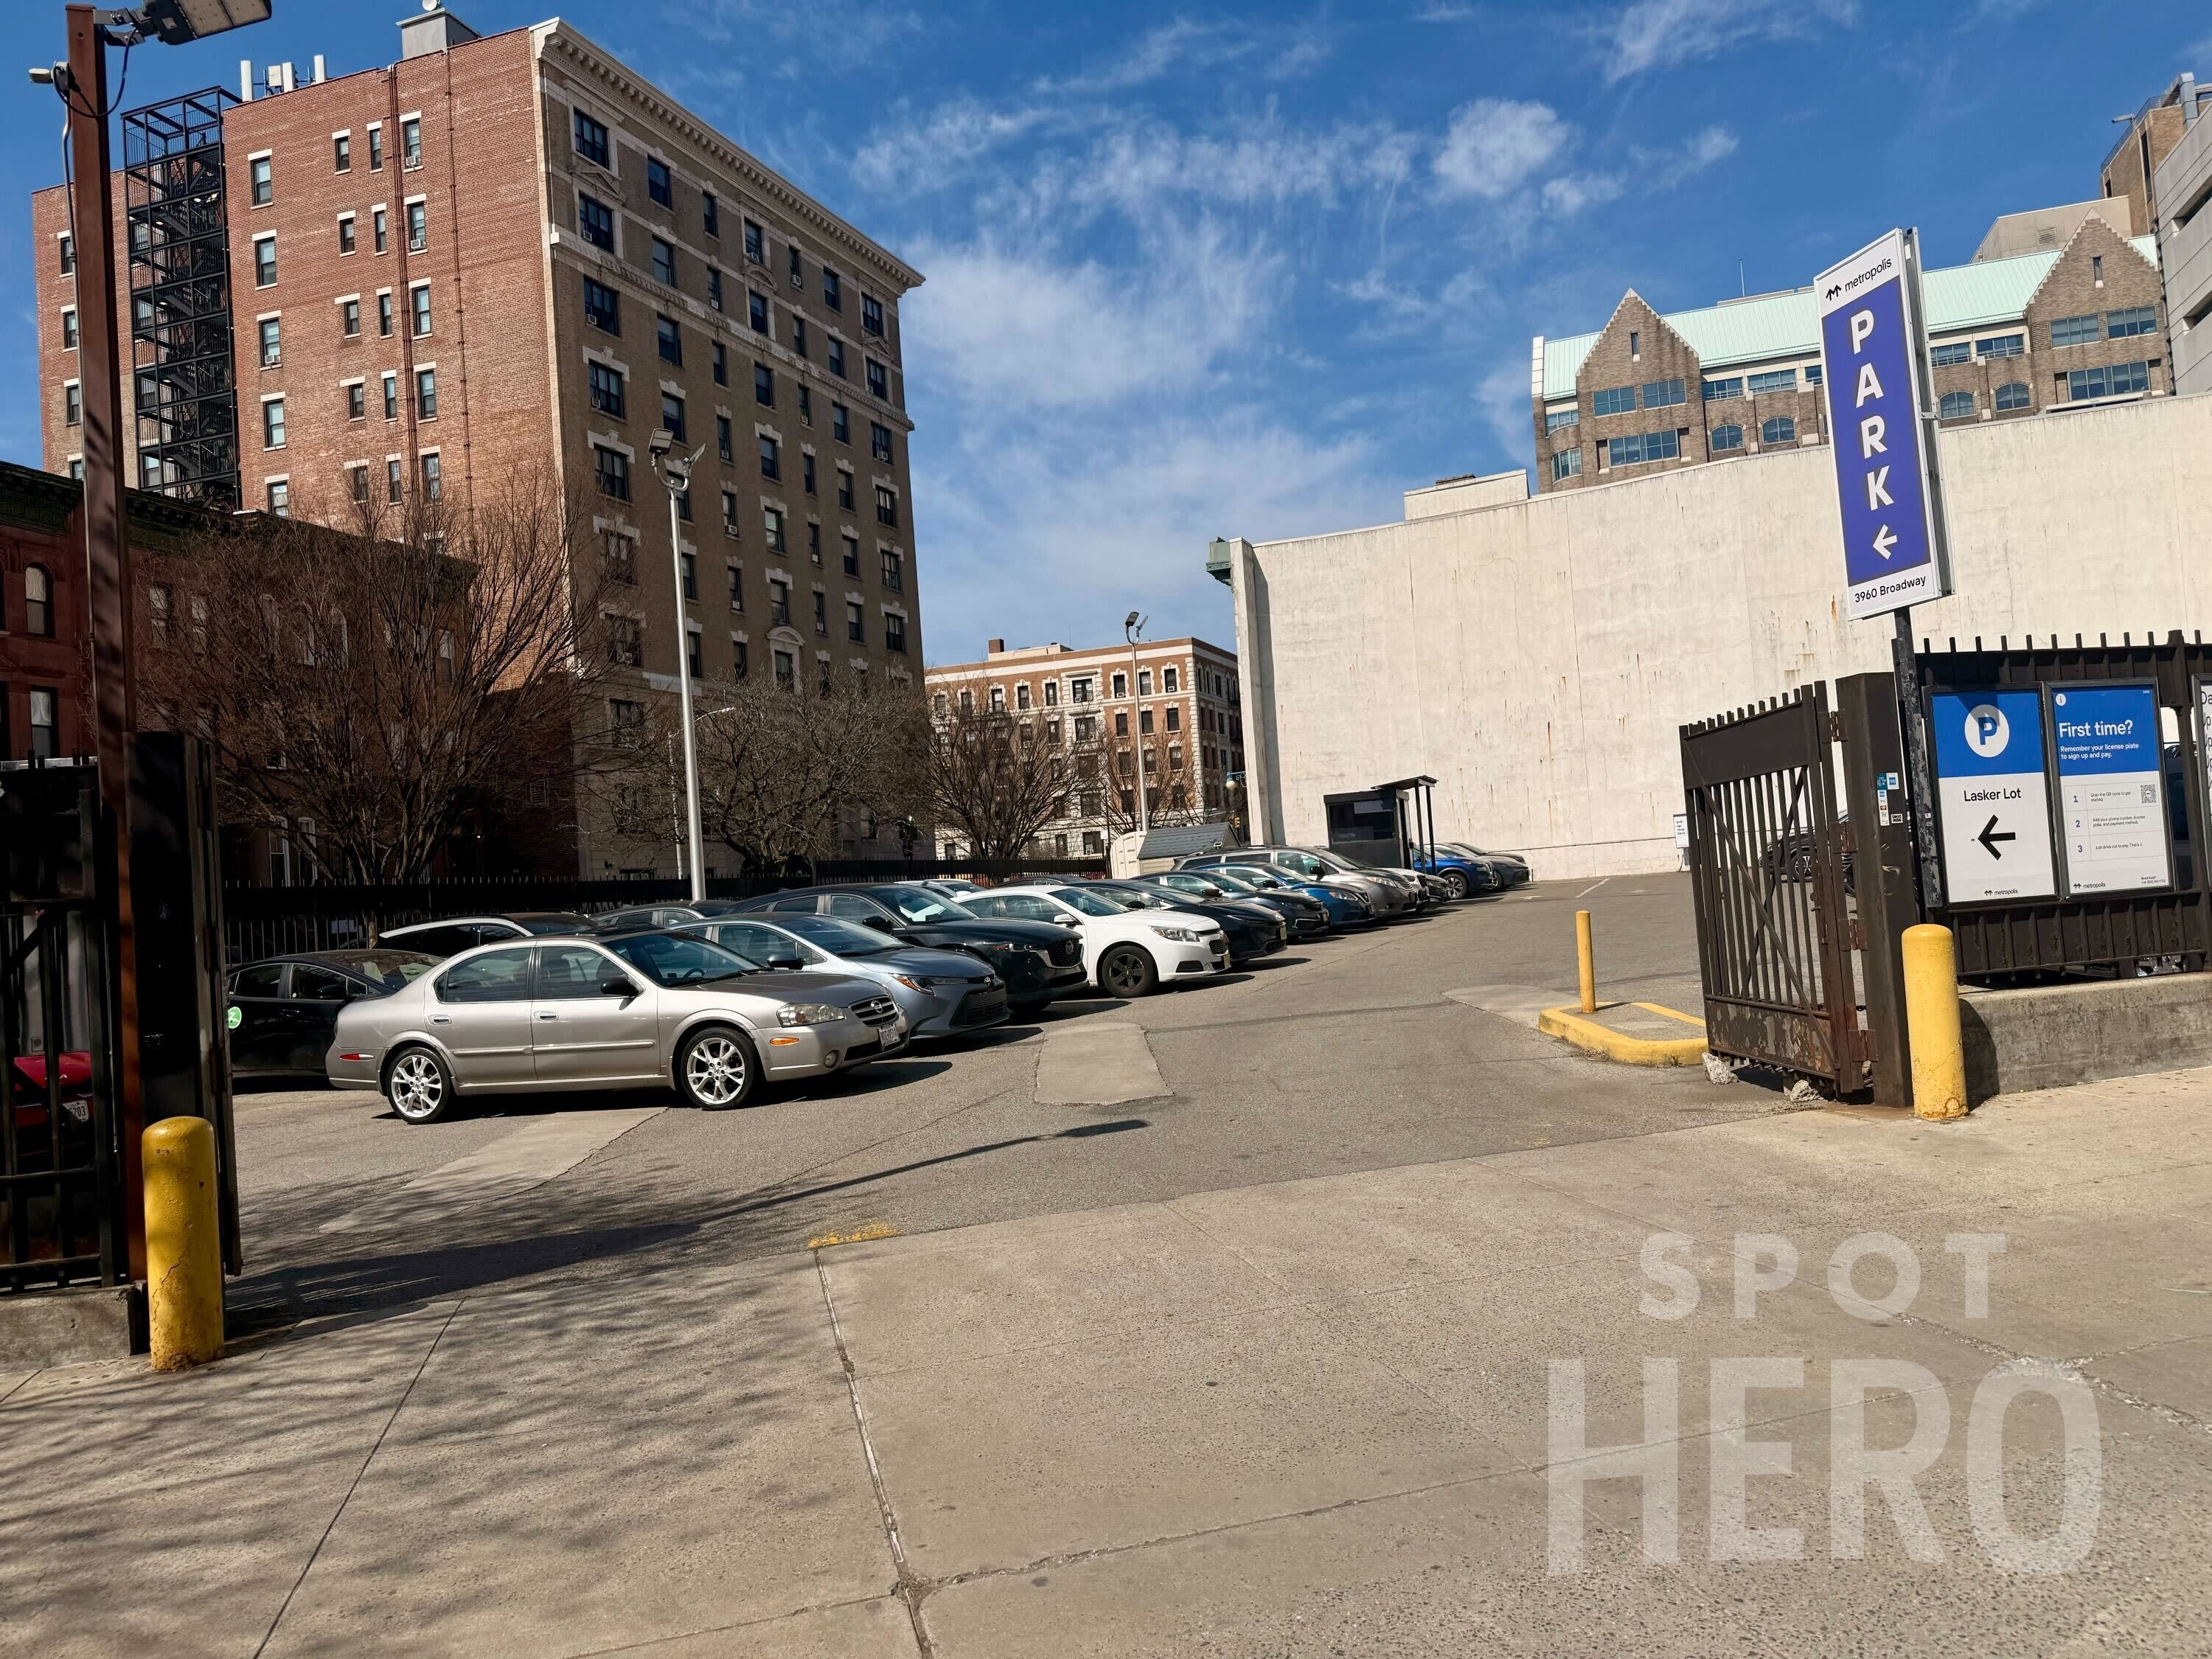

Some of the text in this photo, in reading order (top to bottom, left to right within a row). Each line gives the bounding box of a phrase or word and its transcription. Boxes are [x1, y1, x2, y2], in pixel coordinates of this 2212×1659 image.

[1845, 258, 1892, 292] metropolis
[1850, 308, 1895, 512] PARK
[1854, 576, 1926, 603] 3960 Broadway
[1978, 717, 1997, 745] P
[2059, 719, 2133, 738] First time?
[1964, 787, 2022, 801] Lasker Lot
